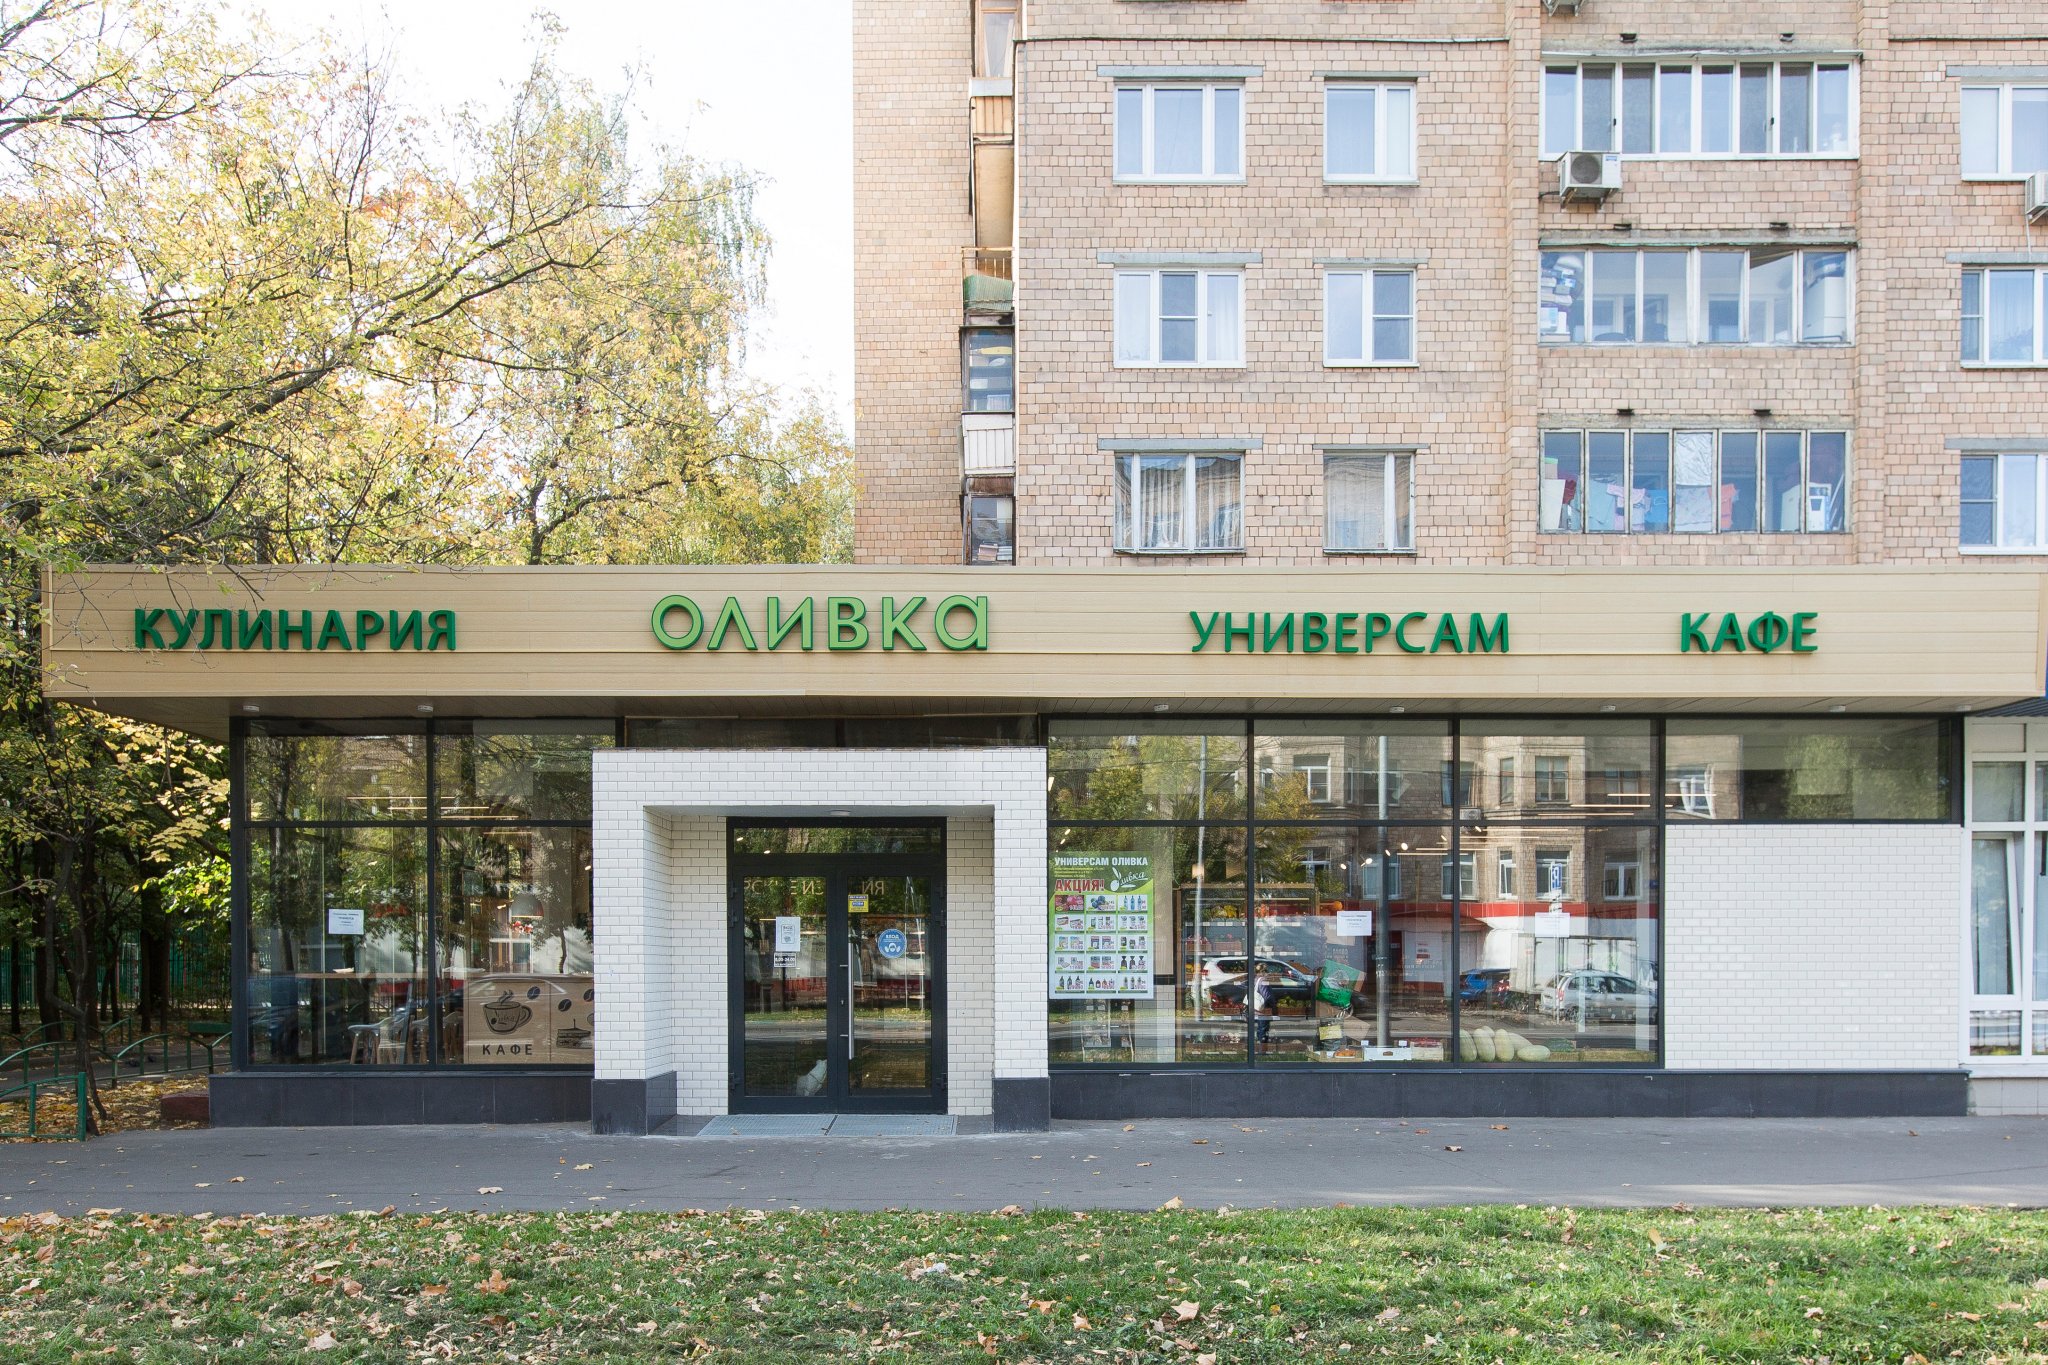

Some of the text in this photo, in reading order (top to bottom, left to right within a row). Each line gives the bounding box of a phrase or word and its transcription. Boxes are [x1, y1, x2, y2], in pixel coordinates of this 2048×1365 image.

[134, 608, 457, 651] КУЛИНАРИЯ
[1190, 610, 1509, 653] УНИВЕРСАМ
[1680, 610, 1819, 653] КАФЕ
[1055, 857, 1148, 866] УНИВЕРСАМ ОЛИВКА
[1055, 879, 1105, 892] АКЦИЯ!
[482, 1044, 533, 1055] КАФЕ
